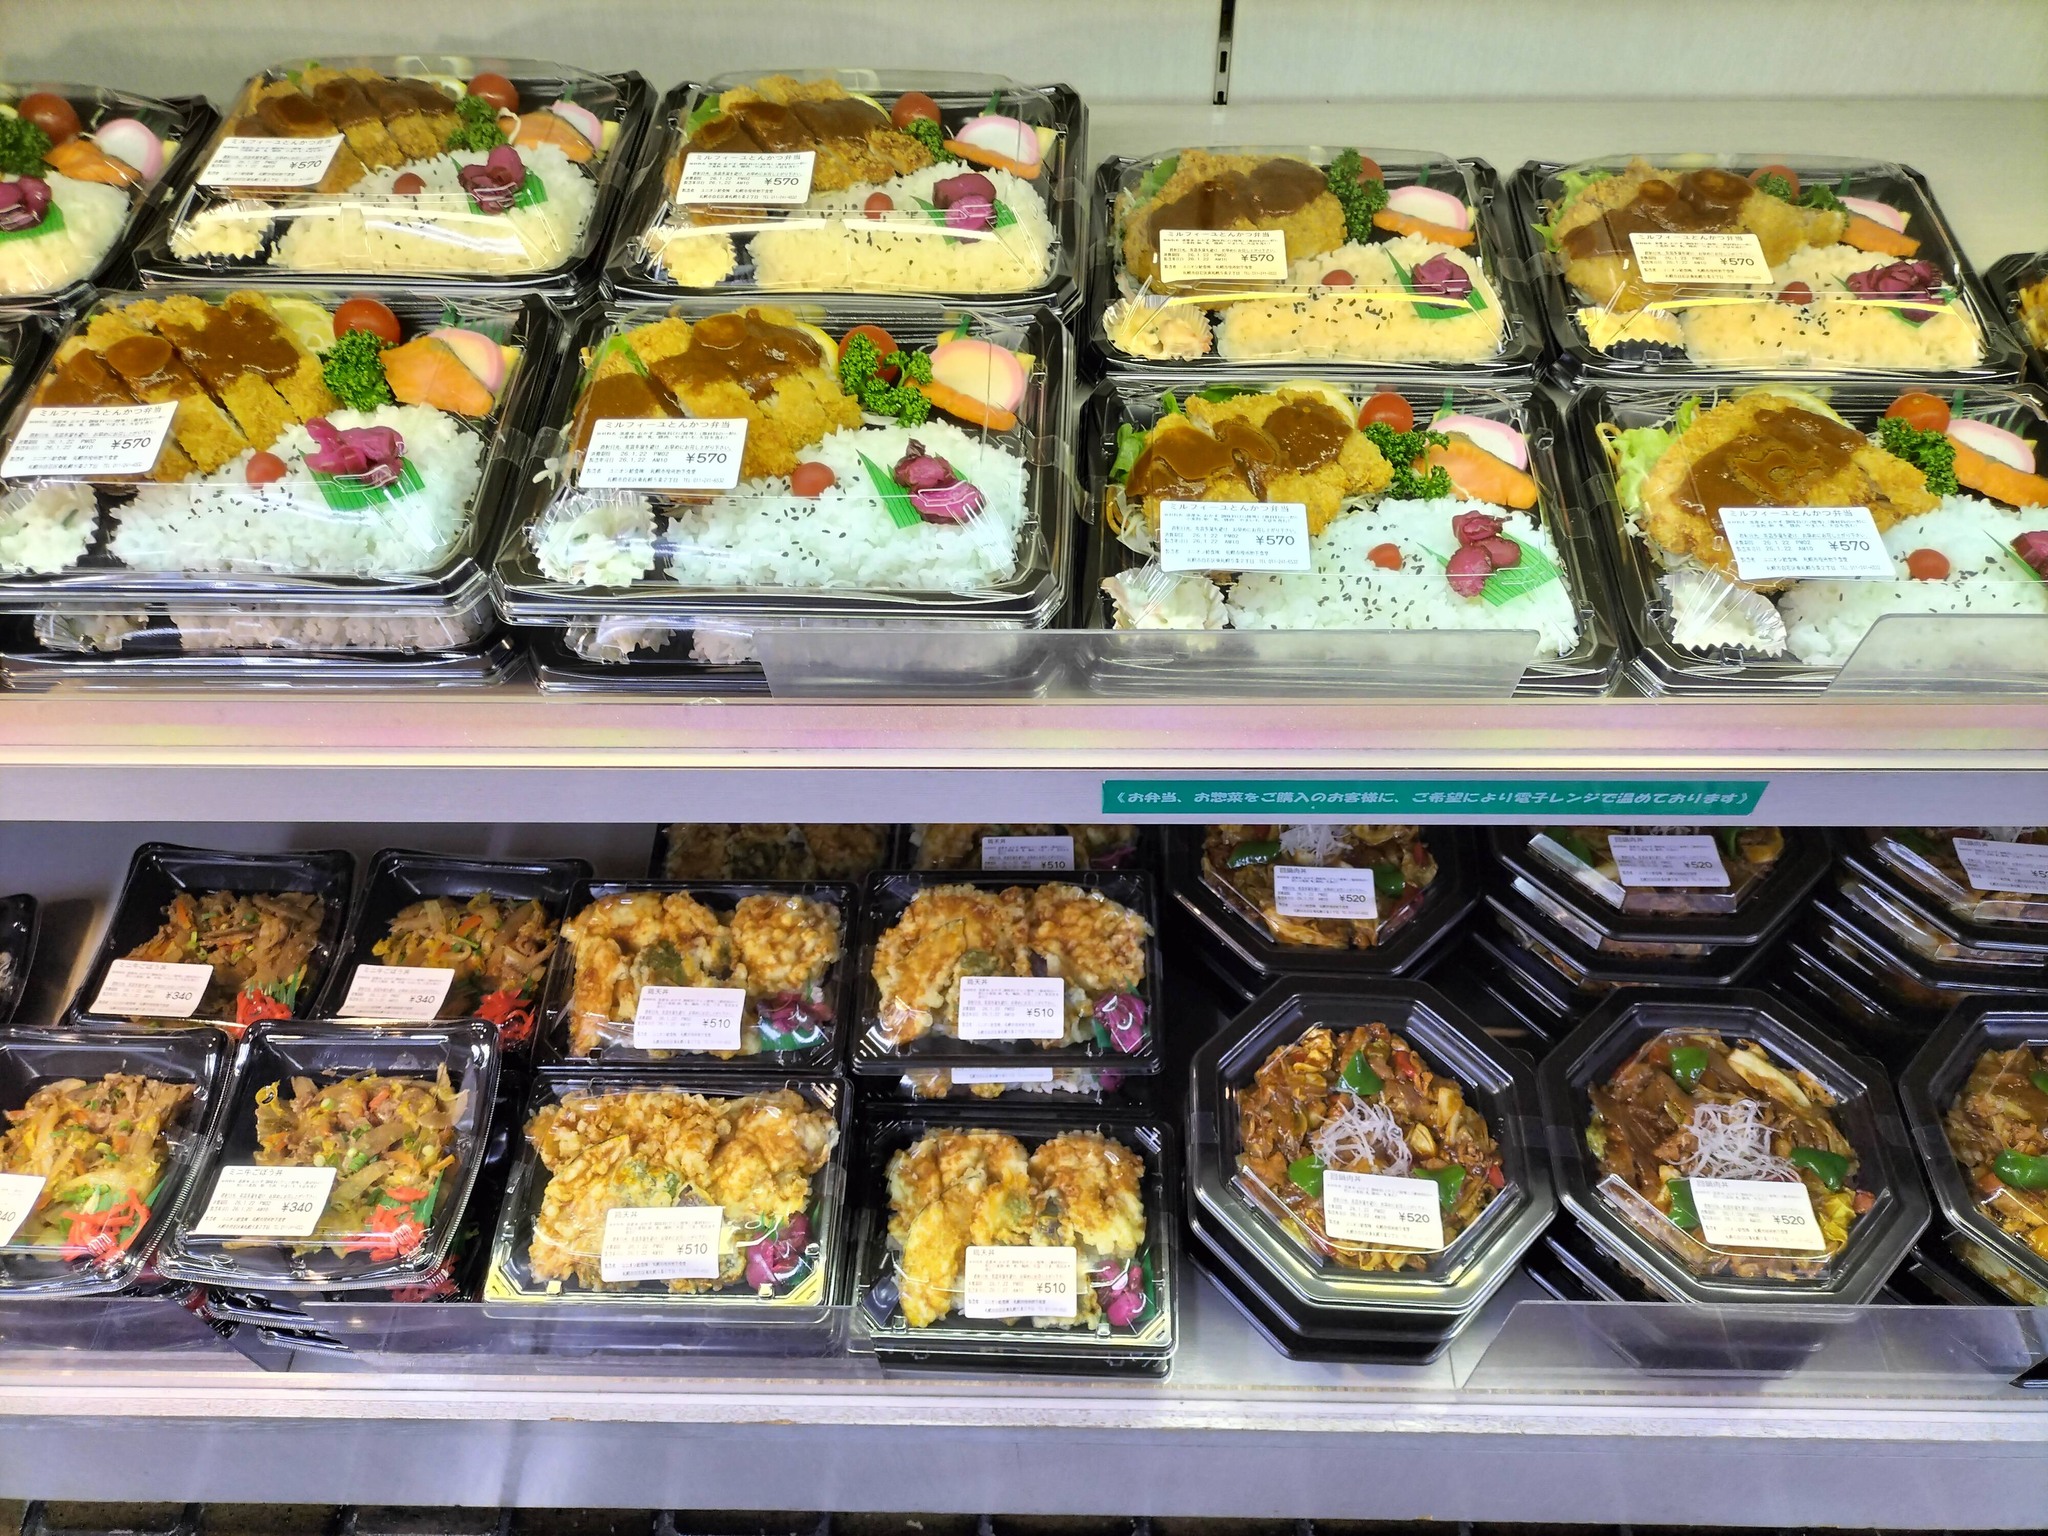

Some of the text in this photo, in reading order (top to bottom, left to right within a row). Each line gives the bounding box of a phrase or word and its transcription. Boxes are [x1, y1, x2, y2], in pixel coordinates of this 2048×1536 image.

[290, 160, 322, 169] ¥570
[765, 177, 799, 186] ¥570
[1241, 254, 1274, 262] ¥570
[1720, 258, 1754, 266] ¥570
[40, 406, 163, 416] ミルフィーユとんかつ弁当
[111, 437, 151, 449] ¥570
[686, 453, 727, 463] ¥570
[1170, 504, 1290, 512] ミルフィーユとんかつ弁当
[1256, 535, 1295, 545] ¥570
[1829, 540, 1870, 551] ¥570
[1684, 861, 1712, 869] ¥520
[1339, 894, 1366, 903] ¥520
[165, 991, 192, 1000] ¥340
[409, 995, 435, 1003] ¥340
[1027, 1008, 1054, 1017] ¥510
[702, 1018, 731, 1028] ¥510
[282, 1202, 313, 1212] ¥340
[1399, 1212, 1430, 1223] ¥520
[1773, 1215, 1805, 1225] ¥520
[677, 1243, 708, 1255] ¥510
[1037, 1283, 1066, 1293] ¥510
